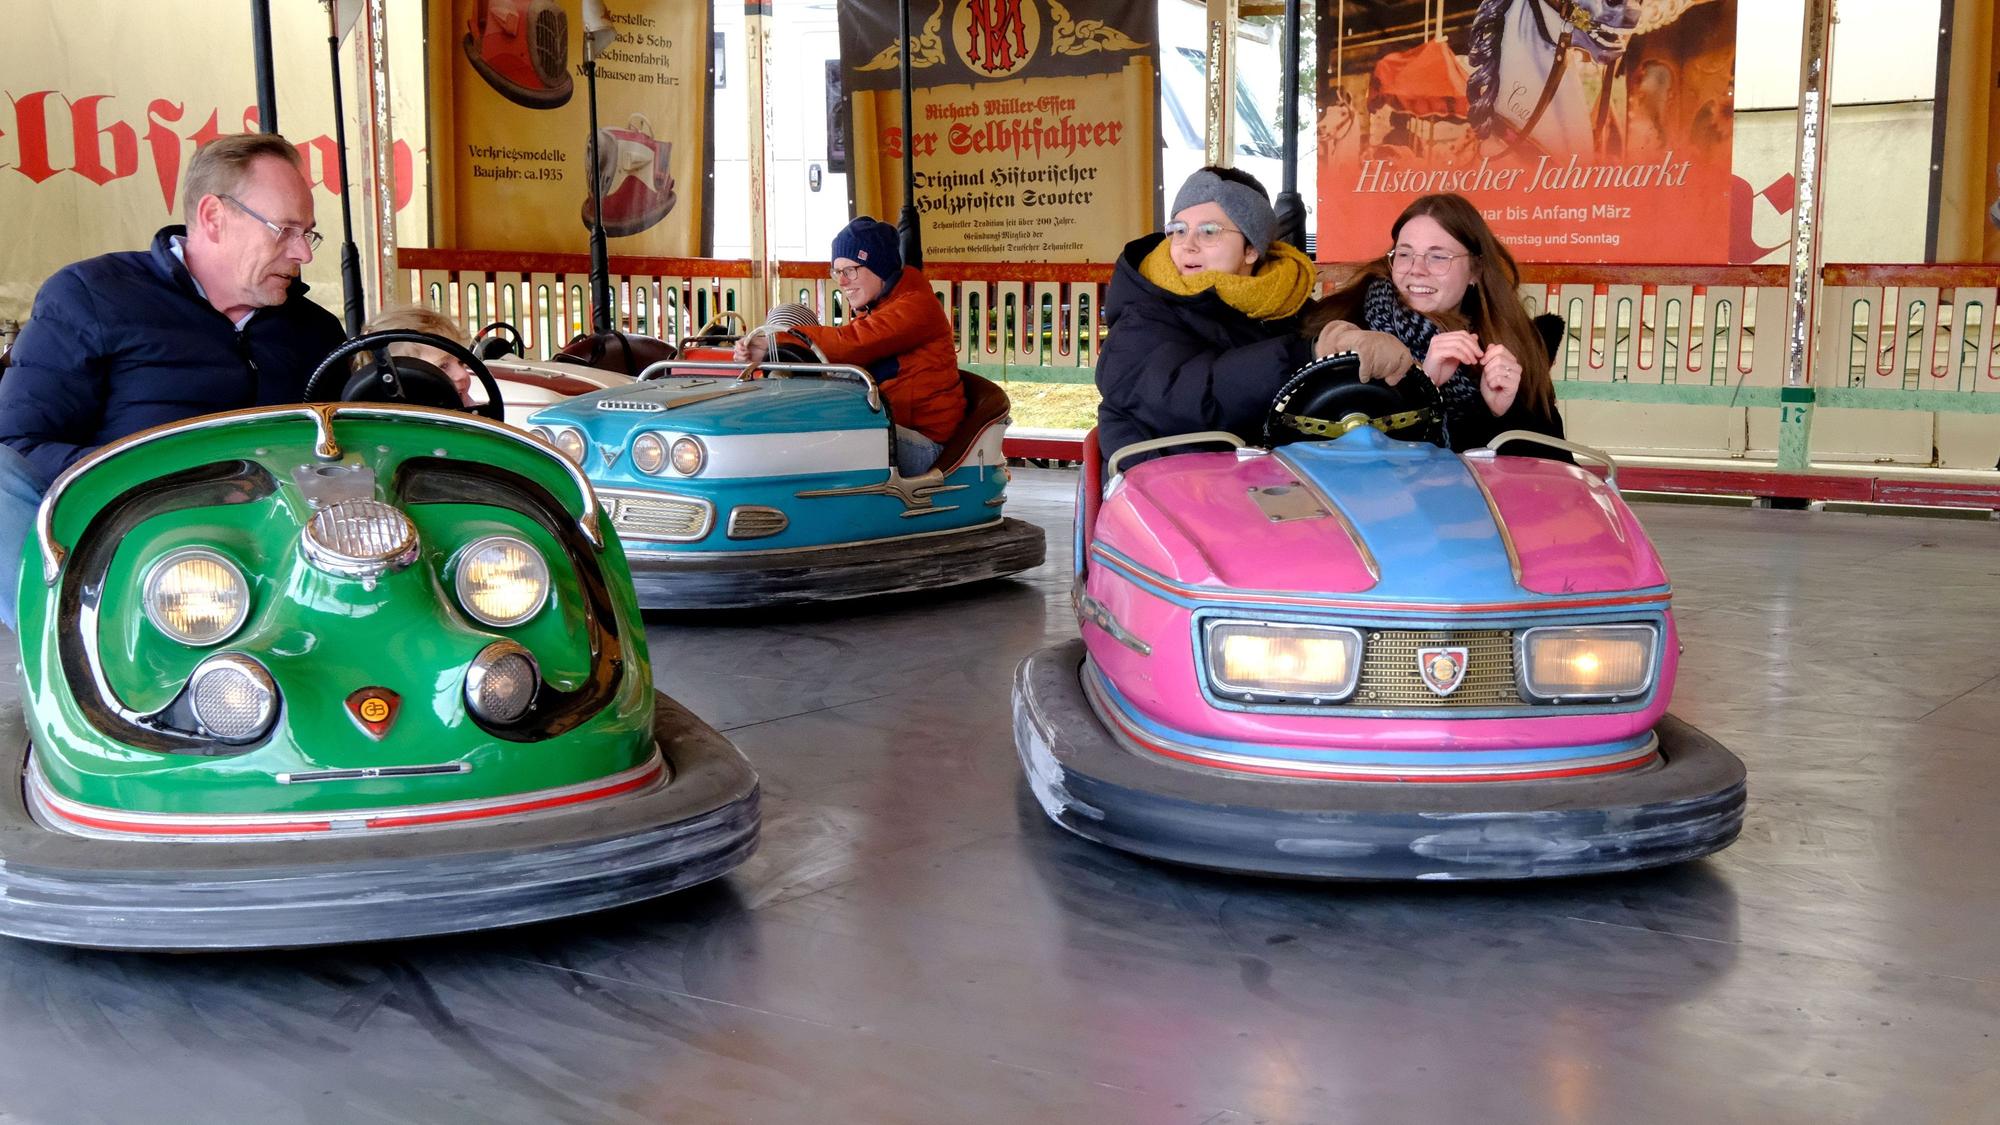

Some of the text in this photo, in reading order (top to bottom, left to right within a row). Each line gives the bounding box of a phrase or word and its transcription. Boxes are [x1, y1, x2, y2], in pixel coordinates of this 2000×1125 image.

[614, 32, 672, 49] ach & Sohn
[595, 49, 670, 68] schinenfabrik
[576, 64, 680, 86] Nodhausen am Harz
[925, 101, 980, 124] Richard
[468, 144, 567, 163] Vorkriegsmodelle
[473, 164, 522, 181] Baujahr:
[912, 163, 1098, 192] Original Historischer
[1352, 150, 1694, 194] Historischer Jahrmarkt
[915, 188, 1094, 216] Holzpfosten Scooter
[1036, 217, 1051, 227] 200
[1480, 203, 1632, 223] uar bis Anfang März
[1545, 233, 1568, 246] und
[1570, 232, 1621, 247] Sonntag
[1780, 405, 1808, 424] 17
